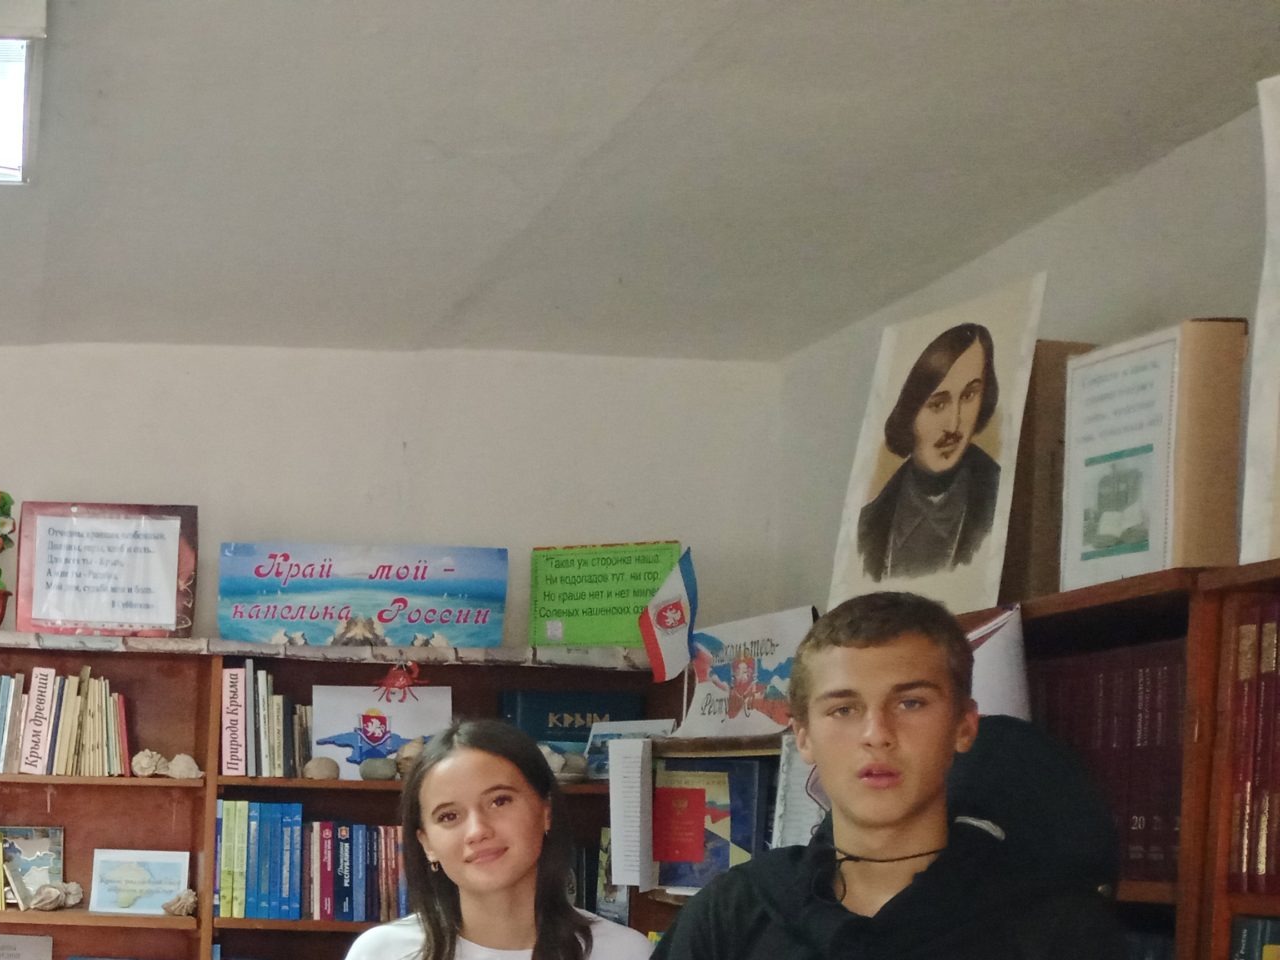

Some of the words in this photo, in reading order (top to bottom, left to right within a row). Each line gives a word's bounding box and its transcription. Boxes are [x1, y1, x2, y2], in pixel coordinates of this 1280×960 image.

[254, 553, 333, 586] Край
[368, 559, 428, 581] мой
[376, 597, 491, 625] России
[589, 590, 603, 600] нет
[615, 588, 630, 599] нет
[29, 672, 49, 727] древний
[226, 673, 242, 716] Крыма
[25, 729, 42, 768] Крым
[226, 719, 243, 771] Природа
